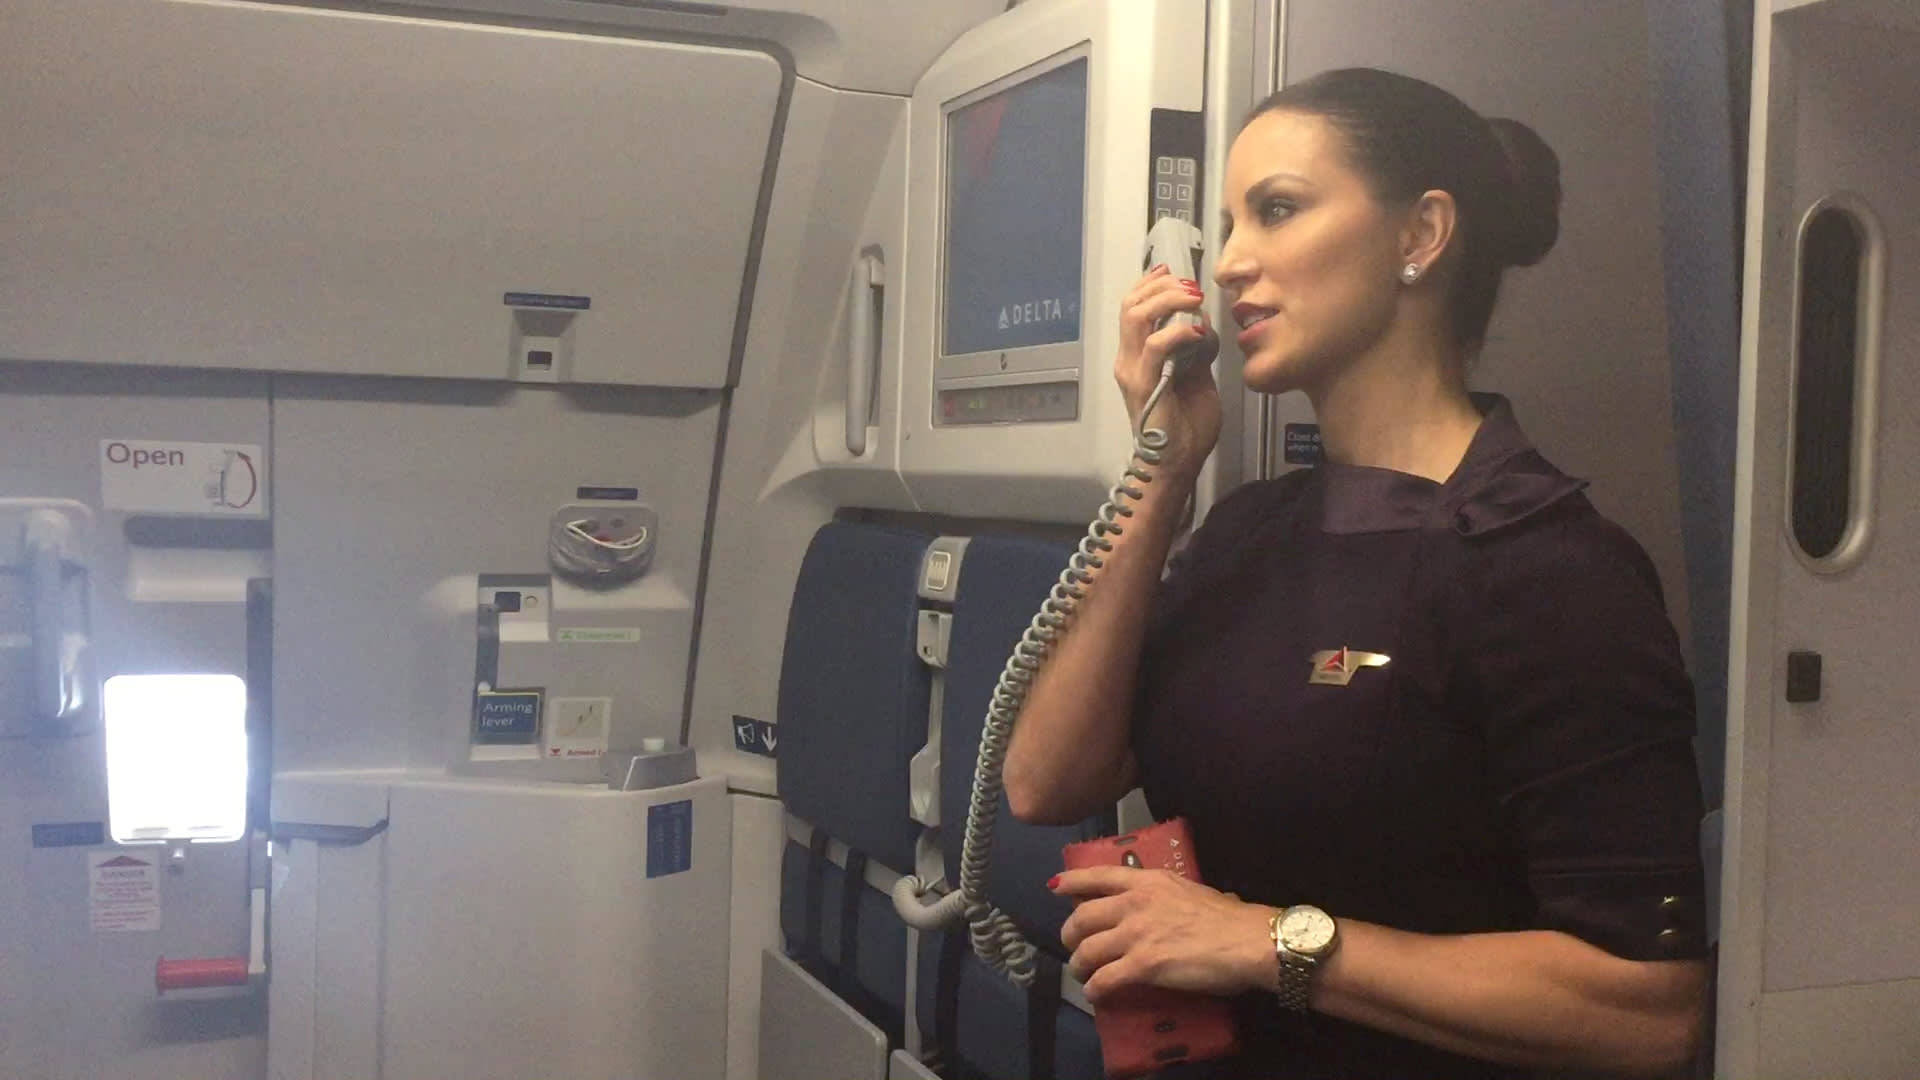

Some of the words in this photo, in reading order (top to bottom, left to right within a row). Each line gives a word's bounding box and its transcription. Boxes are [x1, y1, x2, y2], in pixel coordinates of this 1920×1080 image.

[1013, 298, 1062, 325] DELTA
[107, 442, 184, 469] Open
[482, 703, 533, 715] Arming
[481, 716, 515, 727] lever
